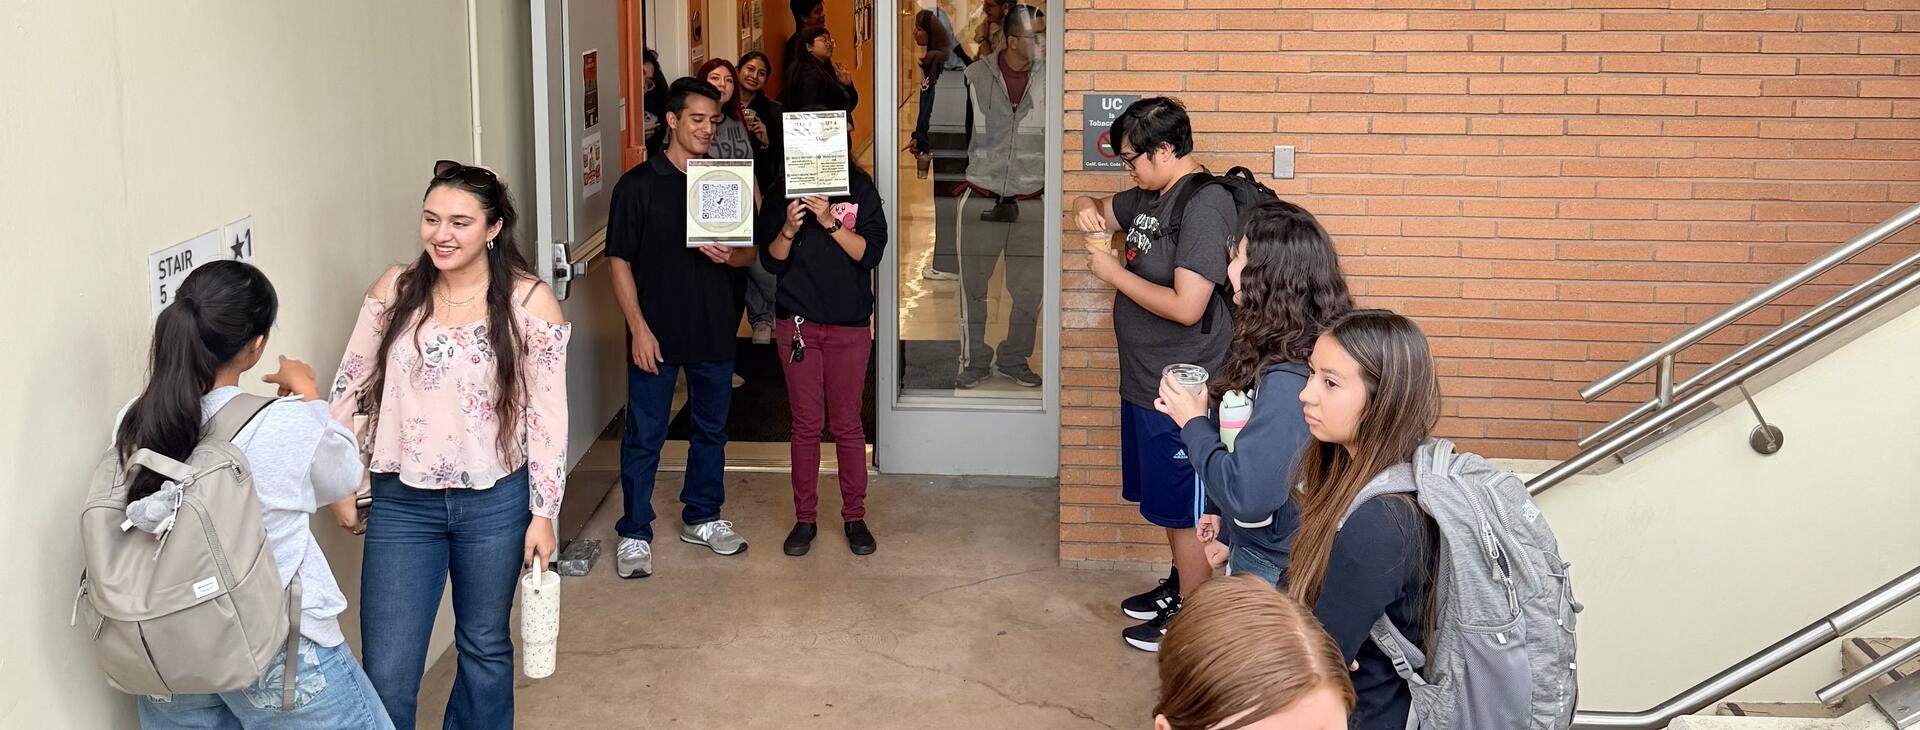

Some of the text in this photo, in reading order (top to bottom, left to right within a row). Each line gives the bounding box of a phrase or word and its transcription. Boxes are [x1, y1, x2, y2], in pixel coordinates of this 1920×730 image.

[1102, 98, 1123, 110] UC
[245, 228, 252, 256] 1
[158, 249, 193, 280] STAIR
[160, 284, 168, 304] 5
